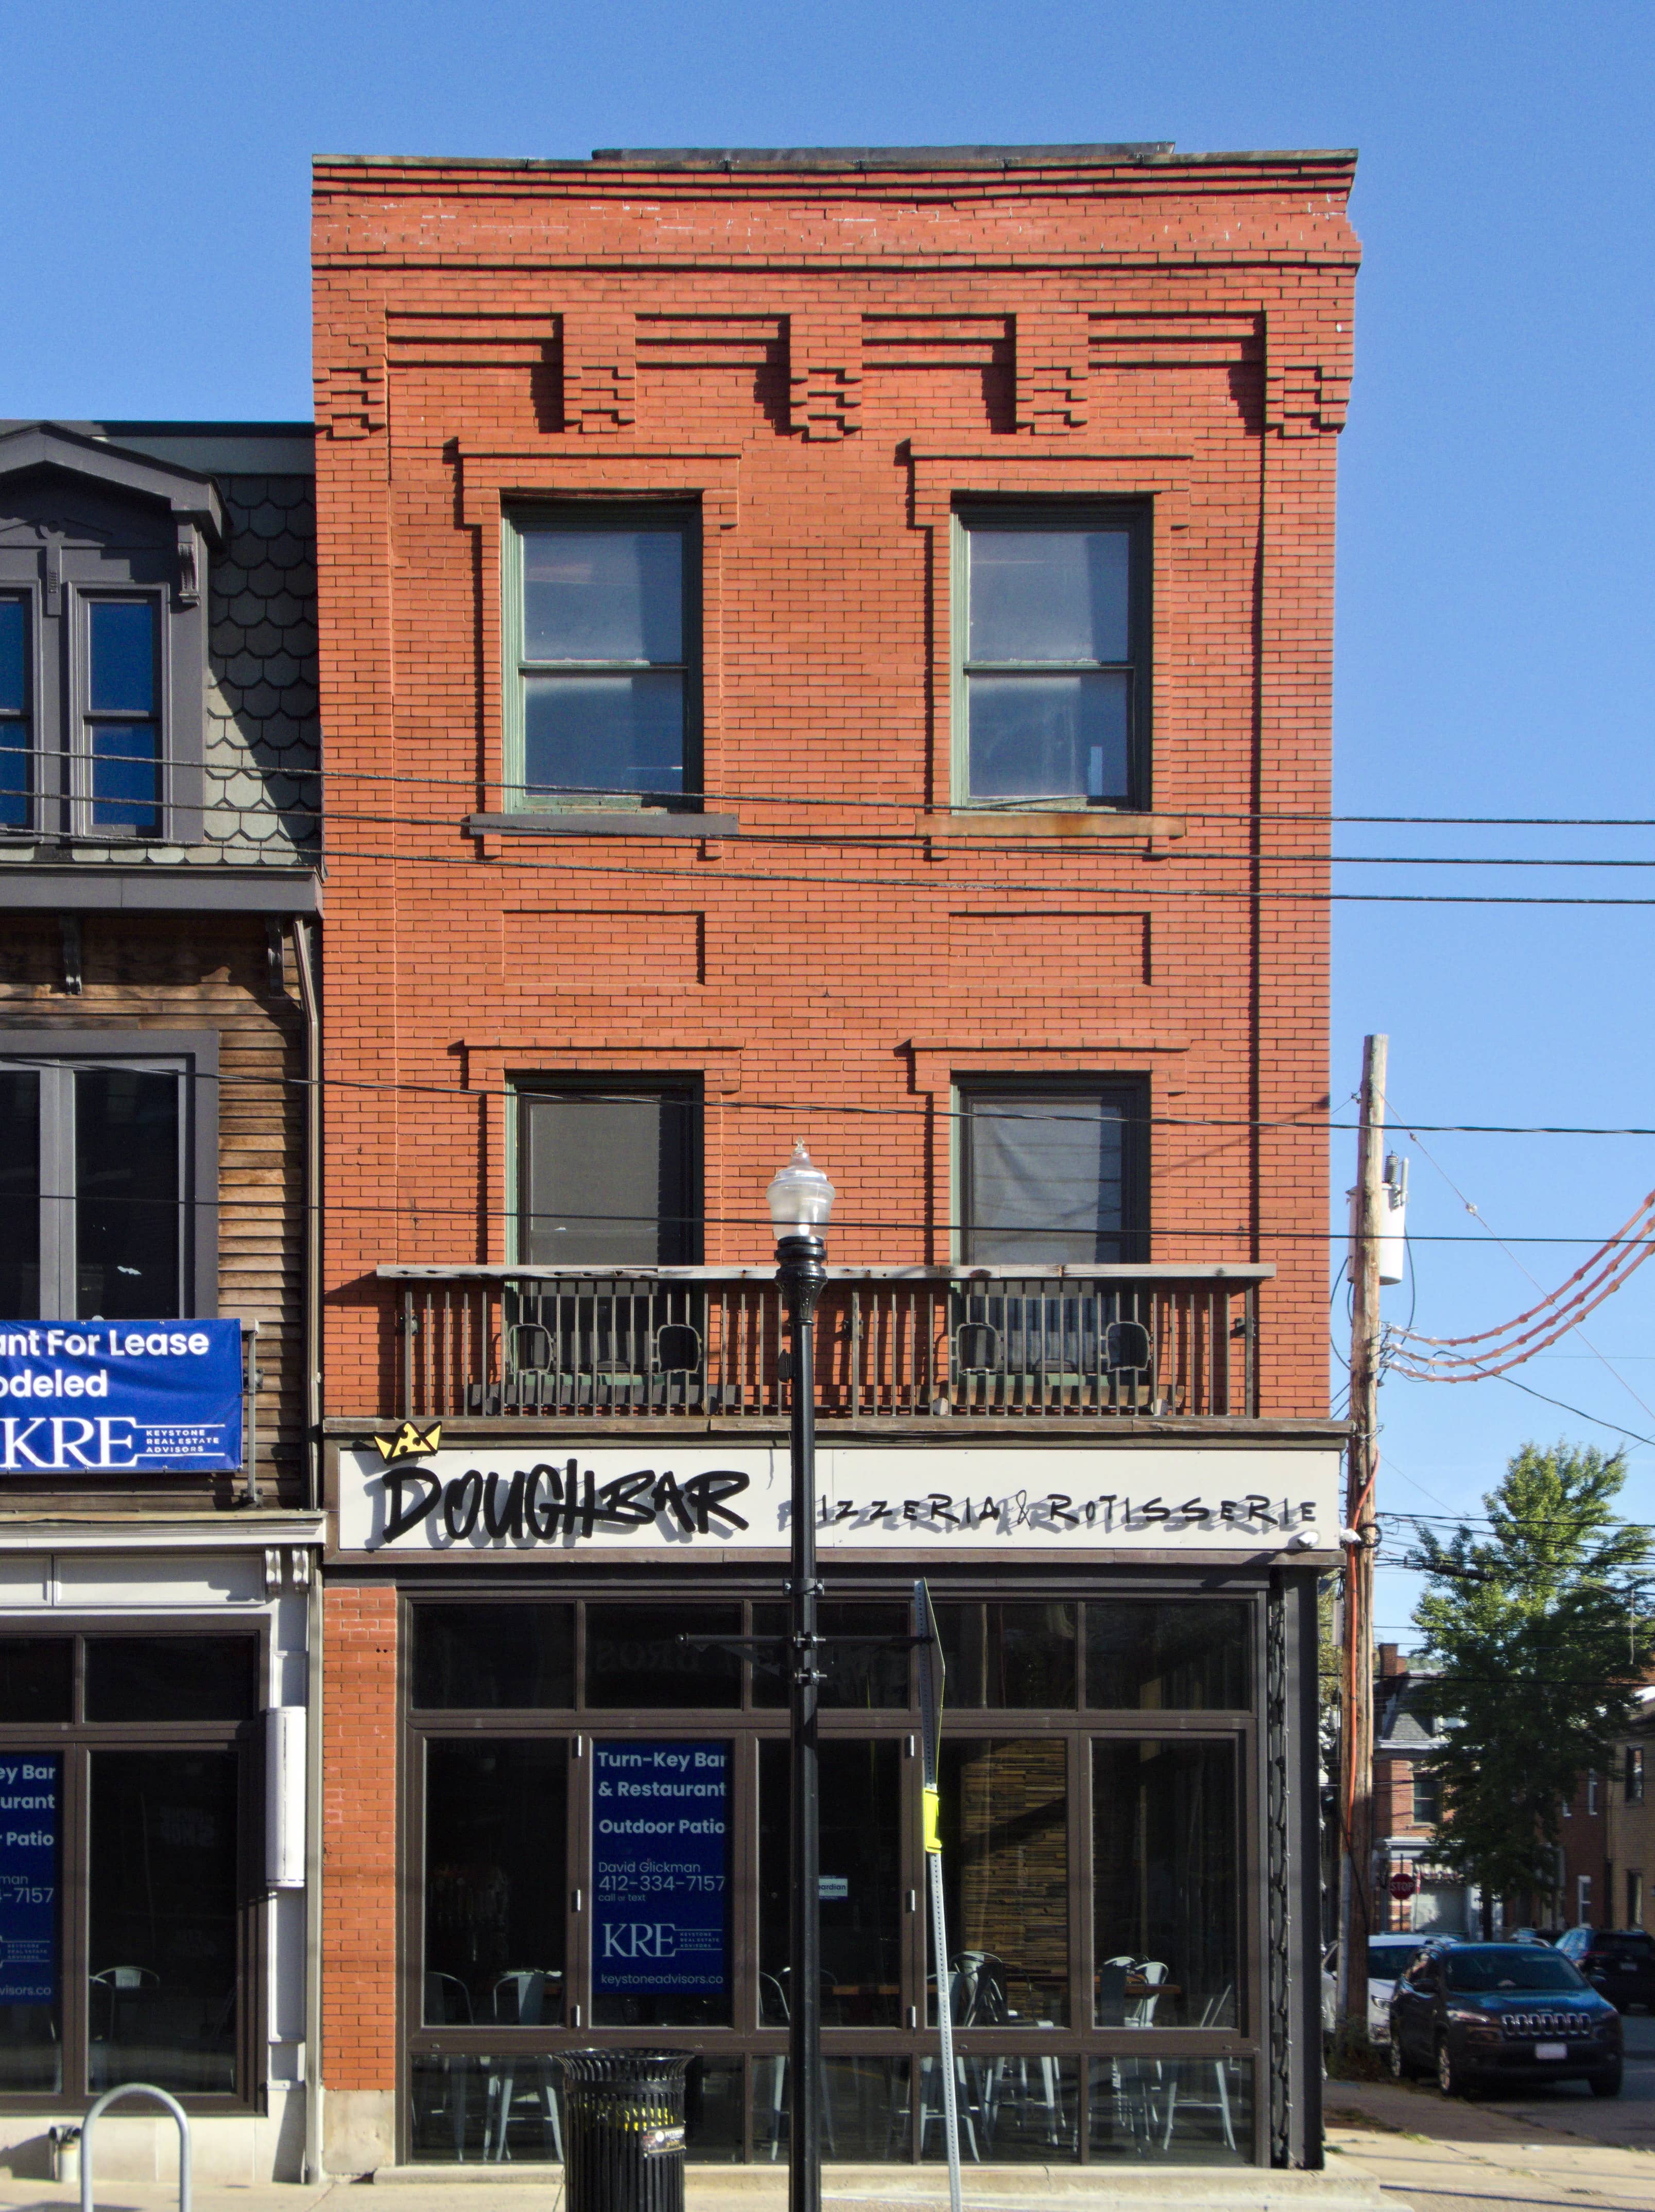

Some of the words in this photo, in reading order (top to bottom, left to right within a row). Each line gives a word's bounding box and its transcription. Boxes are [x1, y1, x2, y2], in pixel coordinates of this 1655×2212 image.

[47, 1329, 100, 1356] For
[110, 1329, 209, 1356] Lease
[0, 1417, 138, 1467] KRE
[822, 1493, 1001, 1524] IZZERIA
[1015, 1489, 1033, 1527] &
[1047, 1493, 1318, 1527] ROTISSERIE
[597, 1752, 690, 1772] Turn-Key
[695, 1752, 726, 1767] Bar
[22, 1764, 57, 1779] Bar
[598, 1782, 613, 1796] &
[617, 1782, 727, 1796] Restaurant
[599, 1819, 675, 1834] Outdoor
[679, 1818, 726, 1834] Patio
[6, 1829, 55, 1846] Patio
[598, 1862, 636, 1873] David
[639, 1862, 701, 1873] Glickman
[598, 1875, 726, 1891] 412-334-7157
[1390, 1882, 1413, 1891] STOP
[598, 1893, 616, 1902] call
[601, 1923, 676, 1957] KRE
